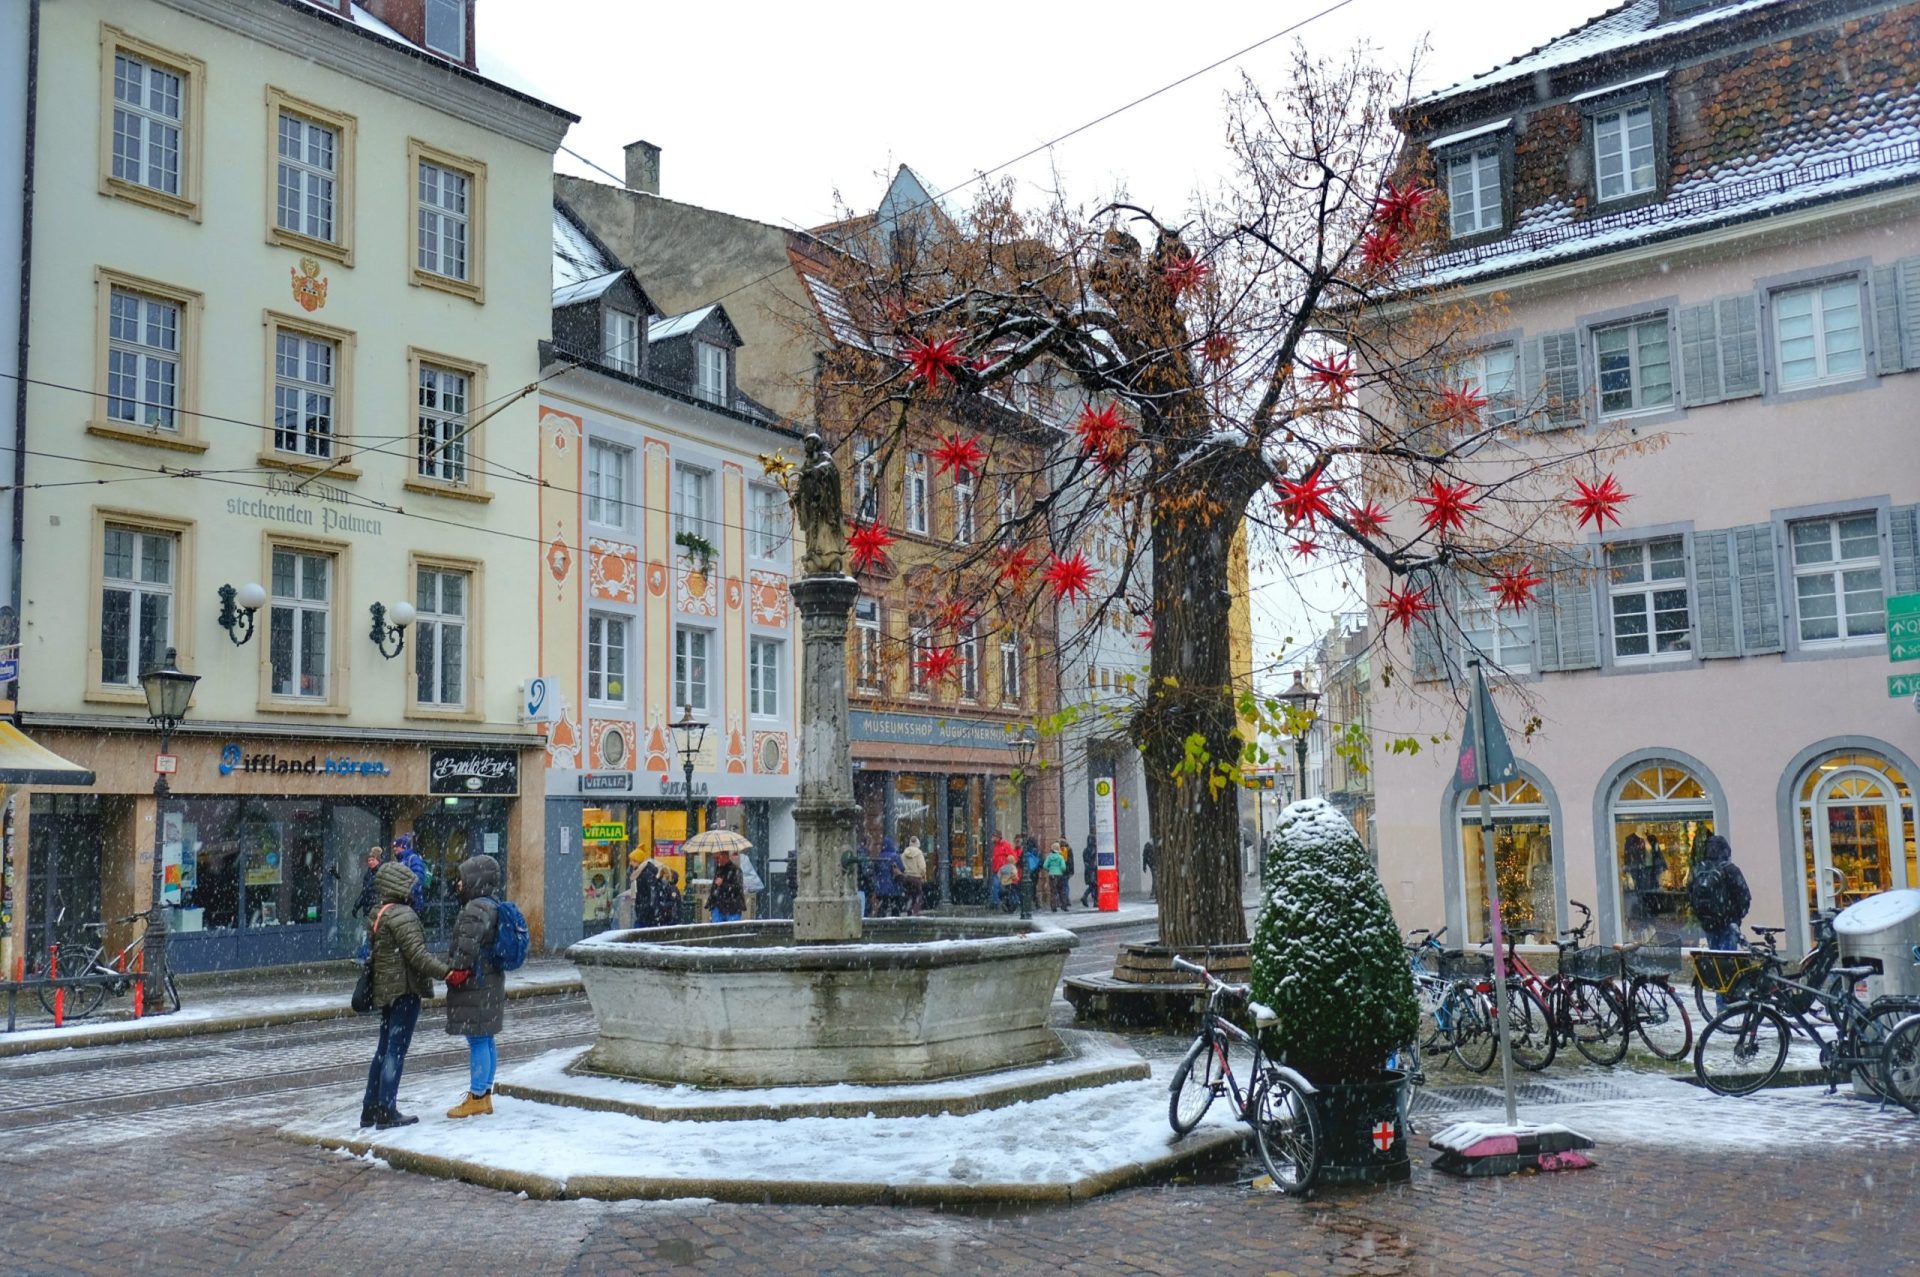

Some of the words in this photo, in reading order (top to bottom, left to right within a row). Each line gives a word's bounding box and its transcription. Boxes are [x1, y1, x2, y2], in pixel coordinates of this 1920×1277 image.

[318, 485, 349, 504] zum
[227, 497, 313, 525] stechenden
[322, 507, 382, 535] Palmen
[864, 720, 933, 736] MUSEUMSSHOP
[585, 776, 624, 788] VITALIA
[584, 827, 622, 837] VITALIA
